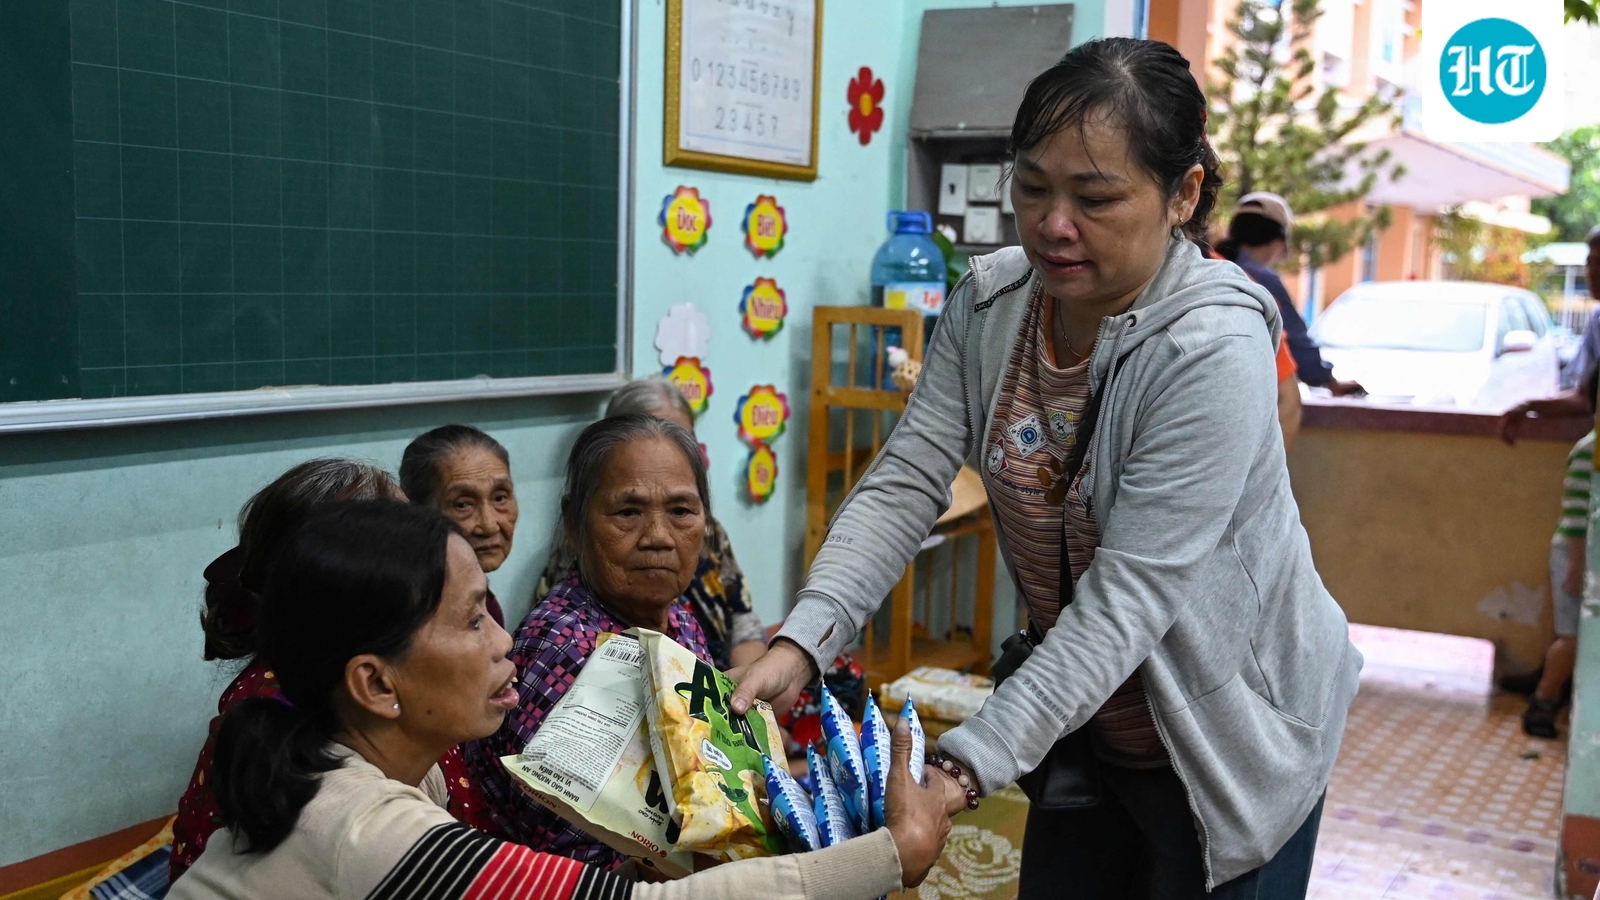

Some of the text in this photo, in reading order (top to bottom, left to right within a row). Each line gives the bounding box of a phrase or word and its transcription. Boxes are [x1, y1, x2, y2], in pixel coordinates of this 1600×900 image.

[1022, 678, 1069, 725] PREMIUM
[521, 765, 532, 773] AN
[523, 785, 557, 809] ORION
[563, 789, 580, 803] BÁNH
[630, 830, 659, 852] ORION
